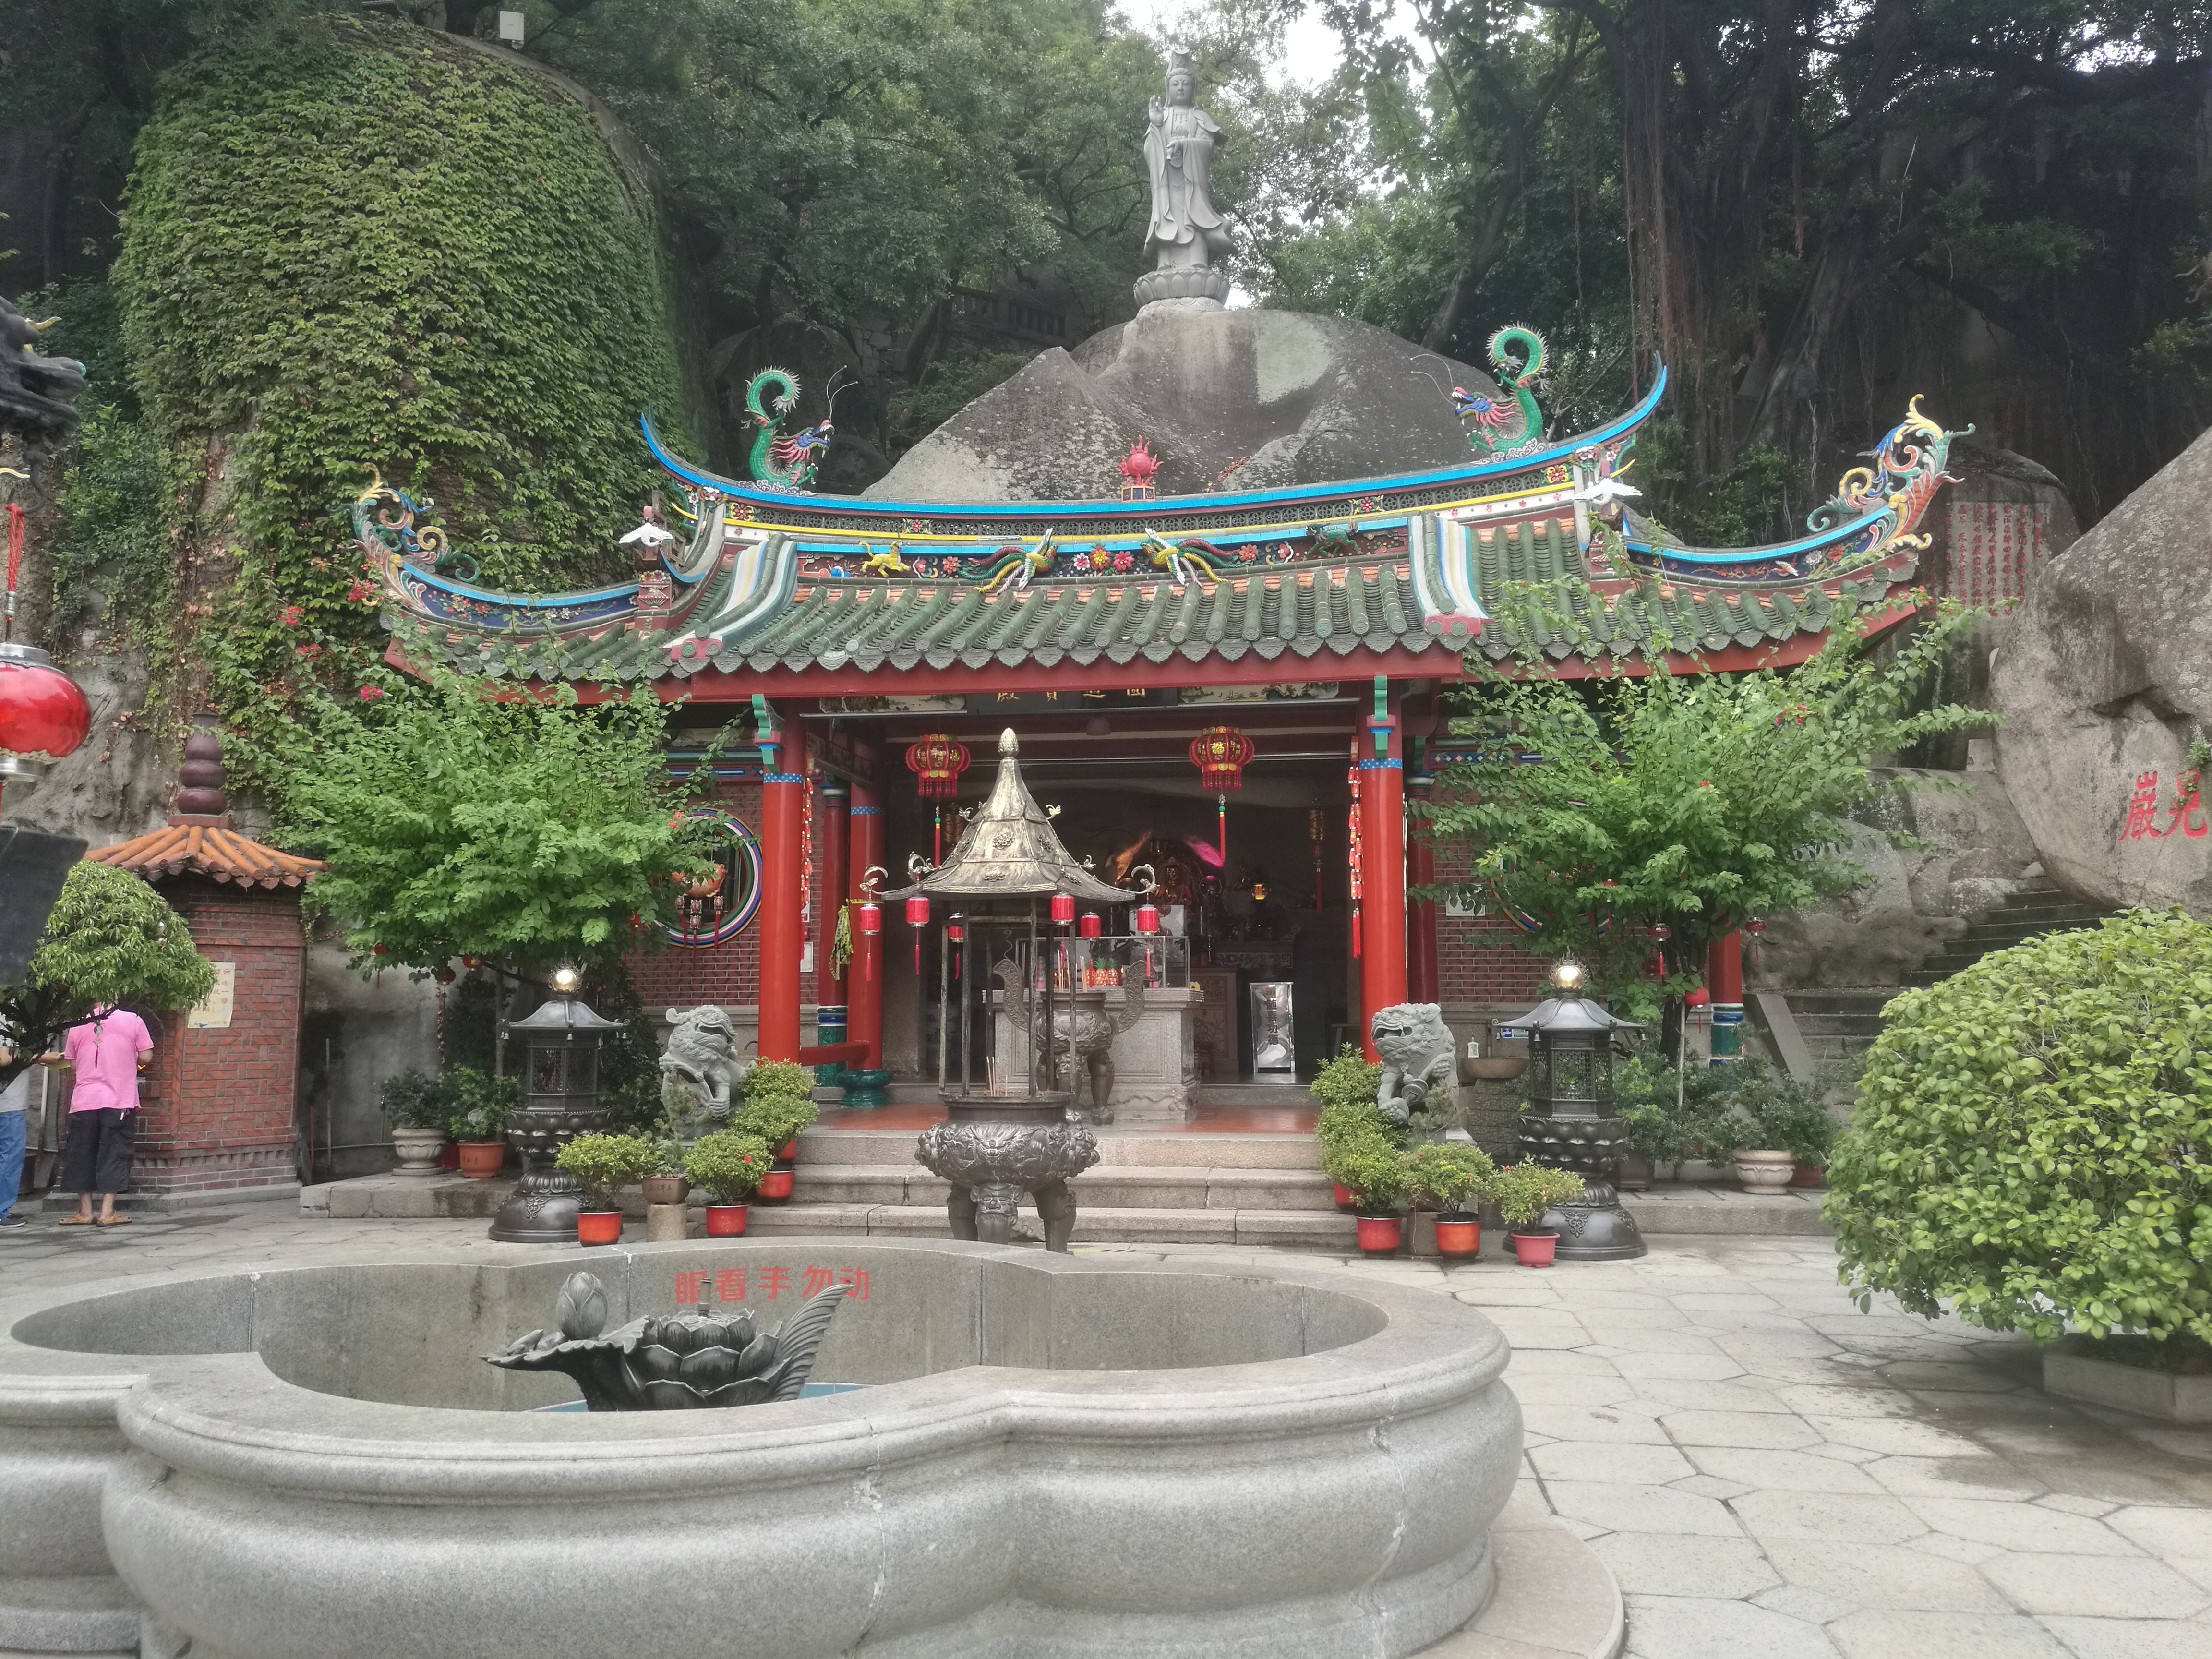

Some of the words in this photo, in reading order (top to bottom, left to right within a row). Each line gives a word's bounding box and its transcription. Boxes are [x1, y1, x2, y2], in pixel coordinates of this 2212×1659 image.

[675, 1265, 869, 1304] 眼看手勿动
